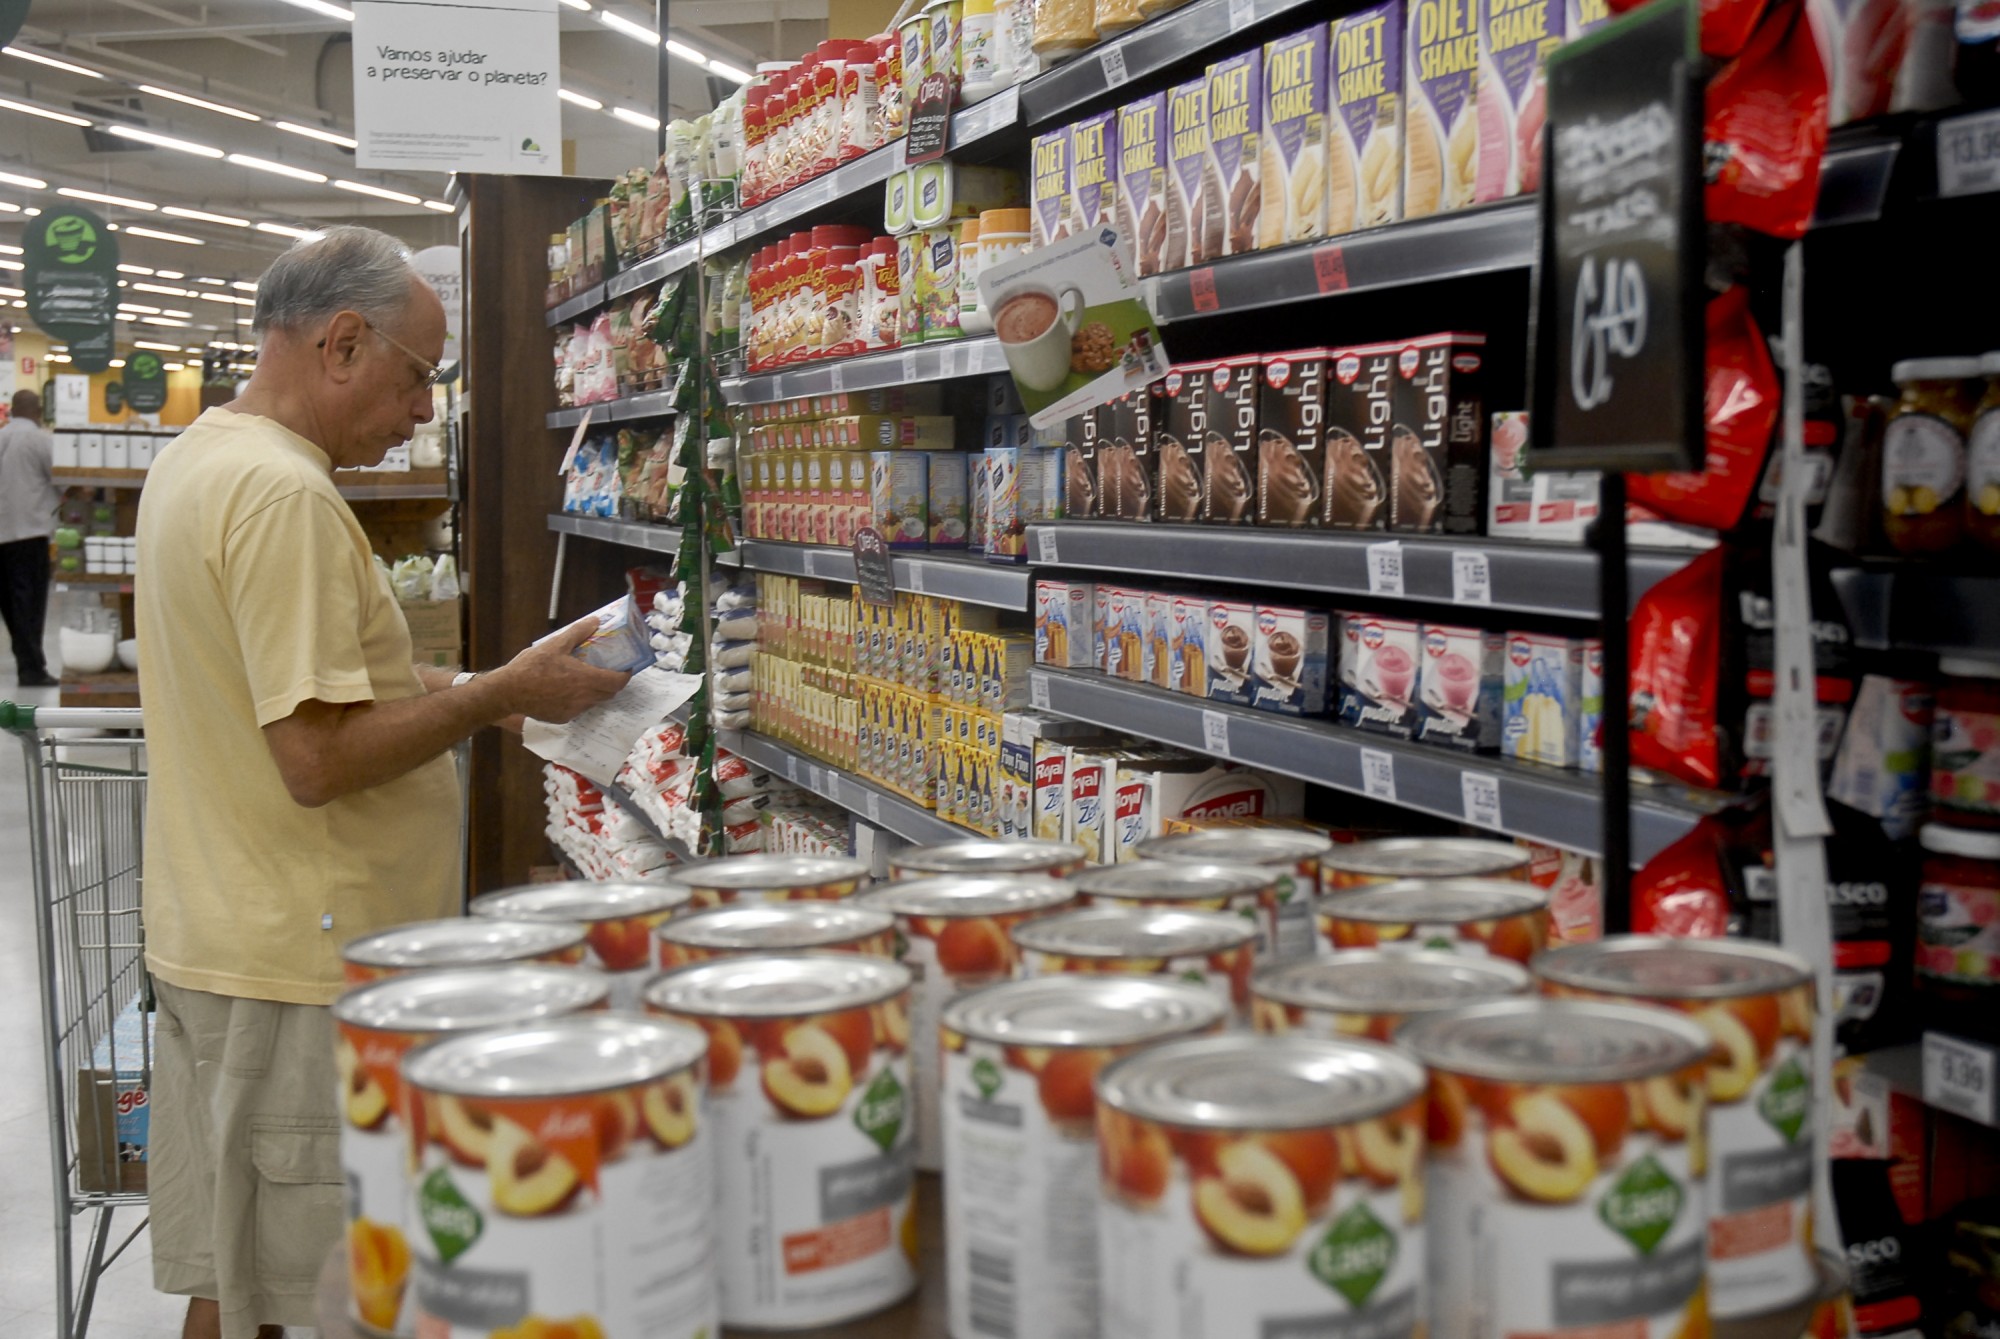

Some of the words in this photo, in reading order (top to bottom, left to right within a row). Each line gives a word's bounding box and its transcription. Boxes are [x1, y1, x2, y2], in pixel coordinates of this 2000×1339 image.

[1338, 17, 1386, 75] DIET
[1489, 2, 1548, 54] SHAKE
[367, 66, 377, 78] a
[383, 66, 462, 81] preservar
[468, 71, 479, 82] o
[484, 70, 547, 86] planeta?
[377, 46, 431, 62] Vamos
[438, 50, 487, 67] ajudar
[1271, 40, 1315, 94] DIET
[1212, 63, 1251, 114] DIET
[1271, 83, 1314, 125] SHAKE
[1338, 61, 1385, 106] SHAKE
[1075, 123, 1105, 163] DIET
[1123, 106, 1158, 150] DIET
[1212, 103, 1249, 143] SHAKE
[1036, 138, 1066, 177] DIET
[1076, 156, 1106, 189] SHAKE
[1124, 141, 1157, 176] SHAKE
[1036, 169, 1065, 202] SHAKE
[1188, 373, 1207, 454] Light
[1234, 367, 1255, 452] Light
[1297, 362, 1322, 450] Light
[1364, 356, 1391, 450] Light
[1423, 349, 1448, 448] Light
[1036, 760, 1064, 783] Royal
[1073, 770, 1098, 795] oyal
